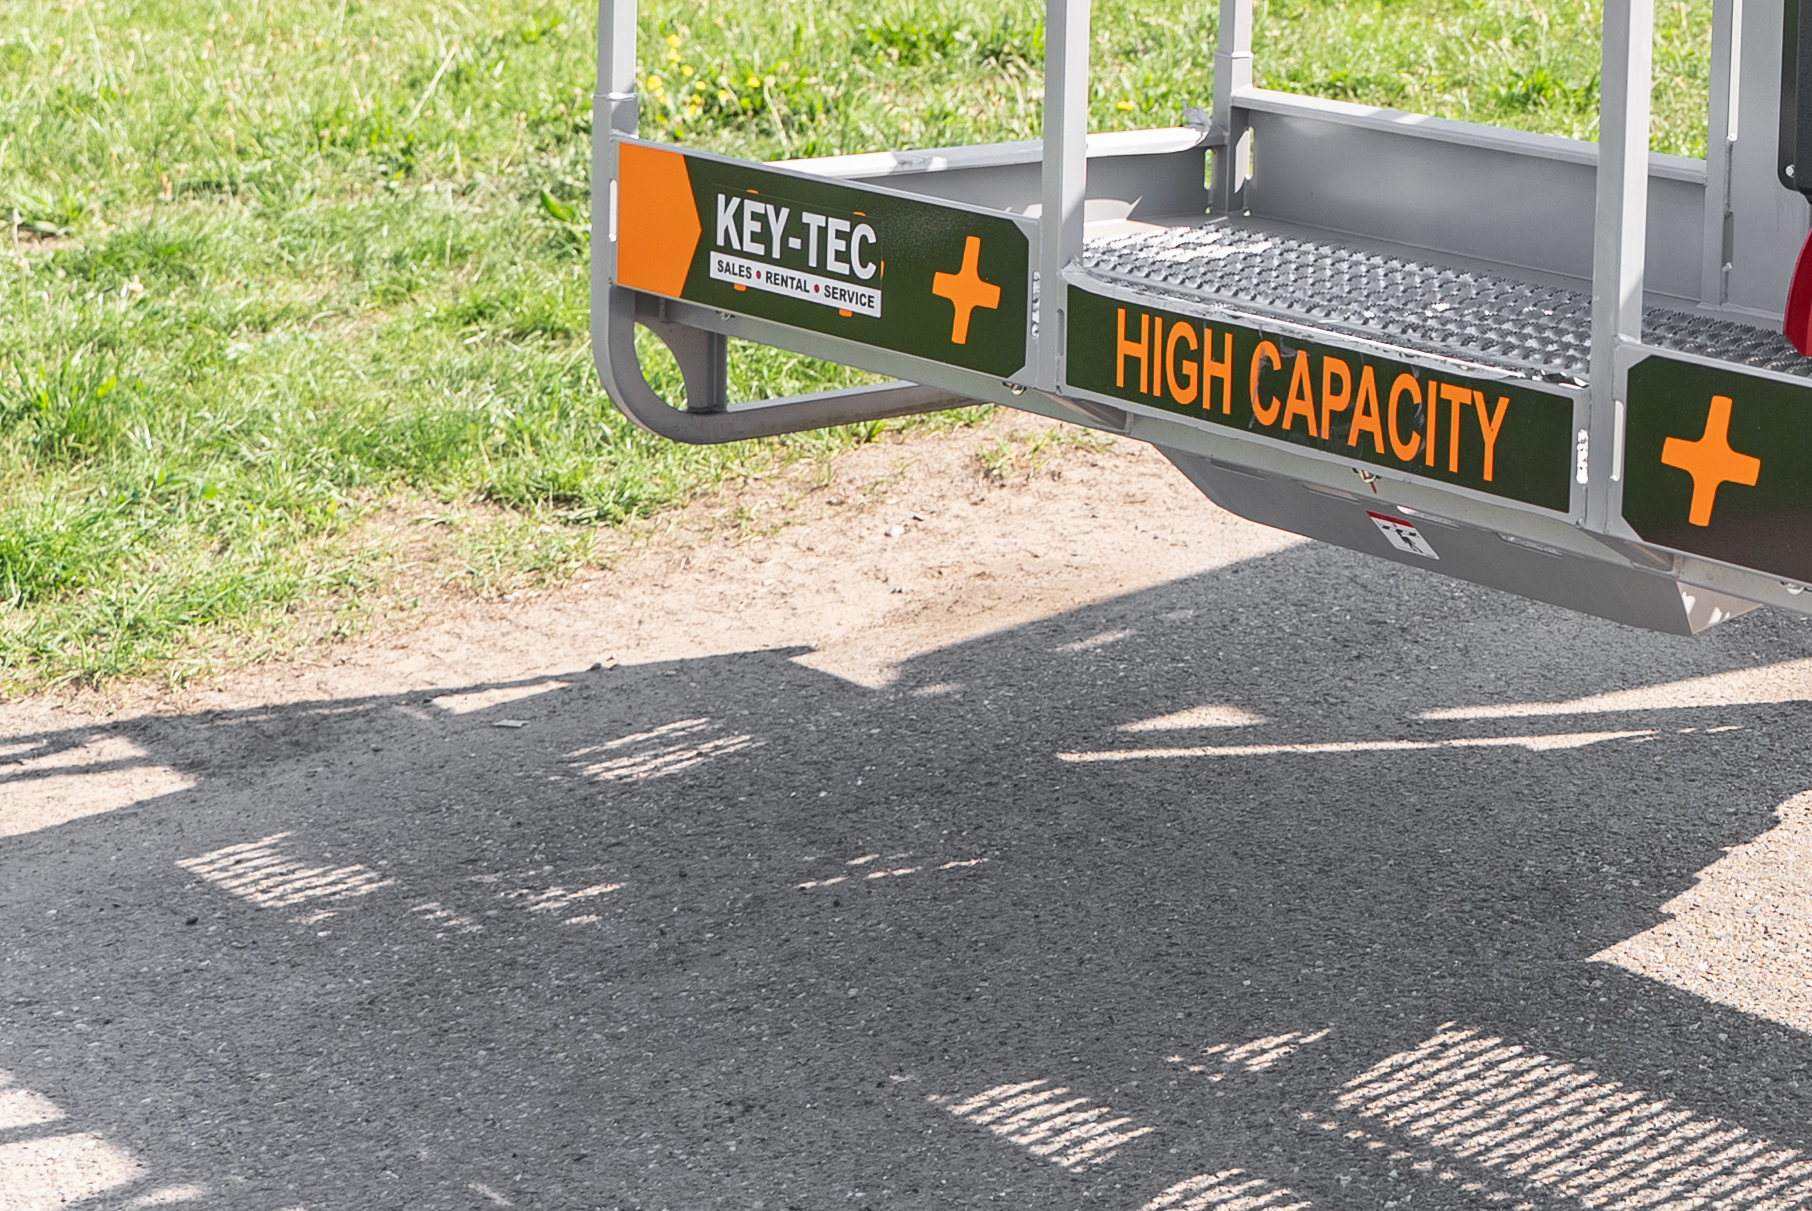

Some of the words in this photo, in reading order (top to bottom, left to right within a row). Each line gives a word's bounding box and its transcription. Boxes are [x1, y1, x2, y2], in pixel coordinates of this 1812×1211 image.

[716, 193, 878, 280] KEY-TEC
[717, 259, 752, 280] SALES
[765, 270, 810, 293] RENTAL
[823, 284, 875, 309] SERVICE
[1117, 307, 1233, 415] HIGH
[1250, 340, 1510, 482] CAPACITY
